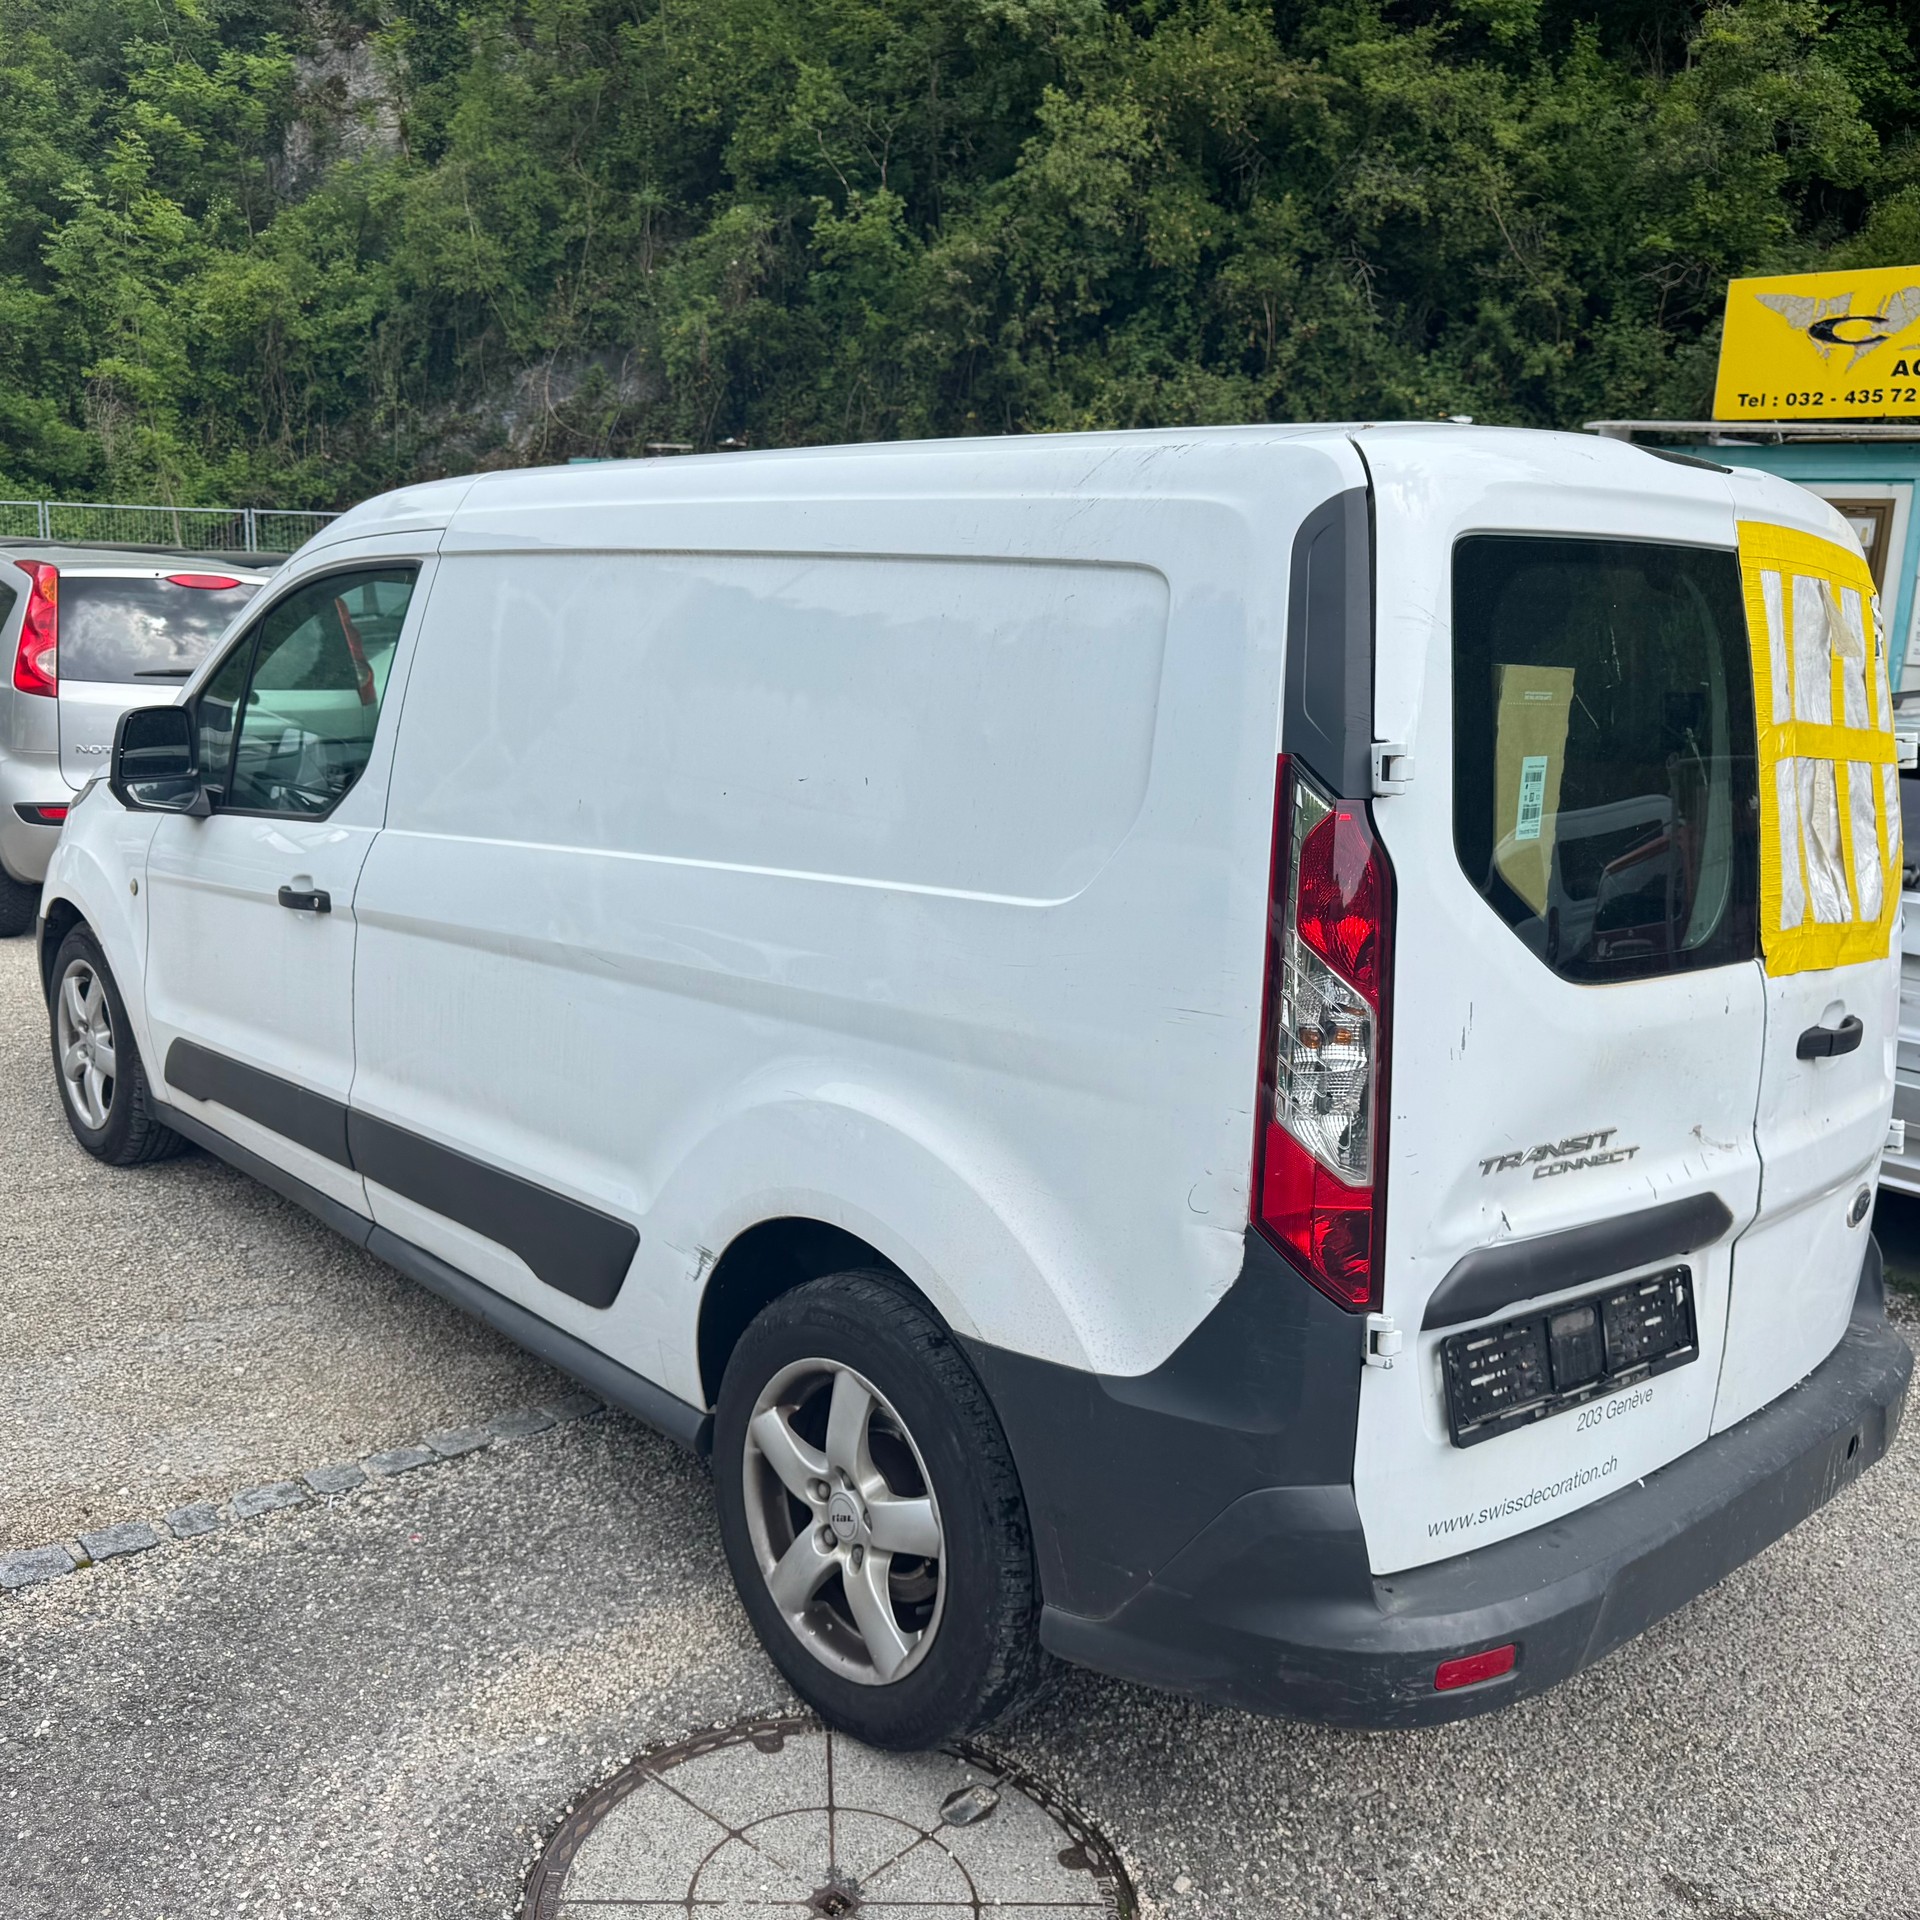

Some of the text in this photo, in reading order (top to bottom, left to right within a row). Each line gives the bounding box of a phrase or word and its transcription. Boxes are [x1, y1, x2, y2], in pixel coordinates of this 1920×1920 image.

[1737, 393, 1766, 407] Tel
[1785, 392, 1824, 406] 032
[1844, 389, 1884, 404] 435
[1890, 387, 1917, 403] 72
[76, 744, 114, 755] NOT
[1478, 1126, 1618, 1177] TRANSIT
[1532, 1145, 1641, 1180] CONNECT
[1576, 1387, 1654, 1432] 203 Genève
[1427, 1455, 1618, 1538] www.swissdecoration.ch
